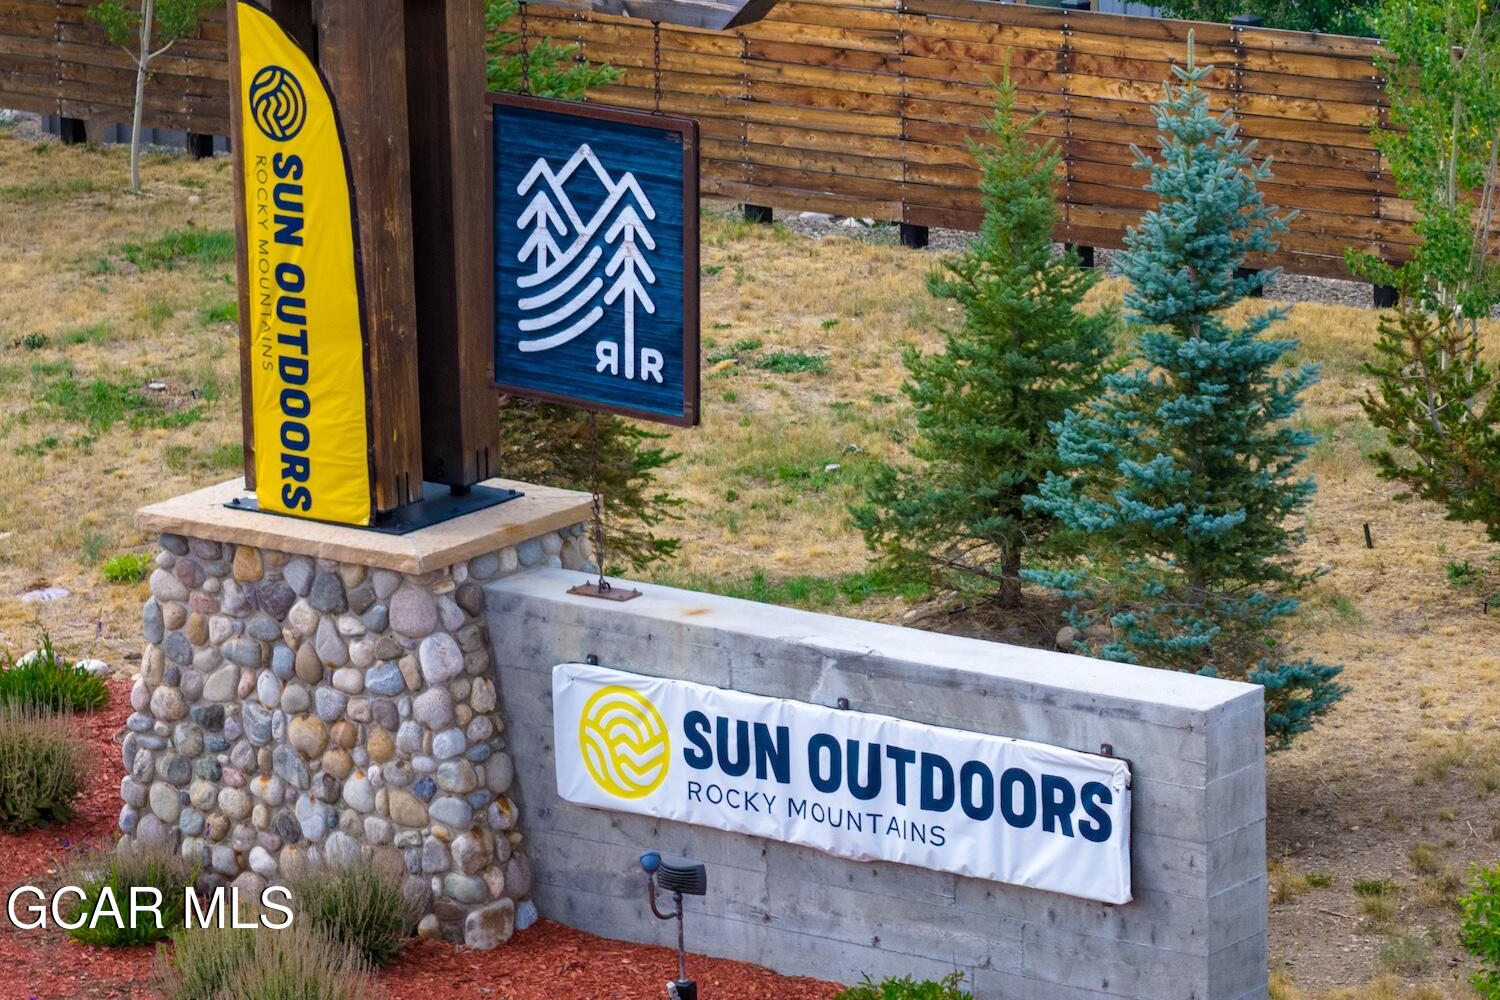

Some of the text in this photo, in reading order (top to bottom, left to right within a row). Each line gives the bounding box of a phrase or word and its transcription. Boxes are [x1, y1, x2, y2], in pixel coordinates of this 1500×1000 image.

[255, 155, 274, 372] ROCKY MOUNTAINS
[272, 152, 312, 512] SUN OUTDOORS
[683, 710, 1113, 843] SUN OUTDOORS
[688, 781, 946, 846] ROCKY MOUNTAINS
